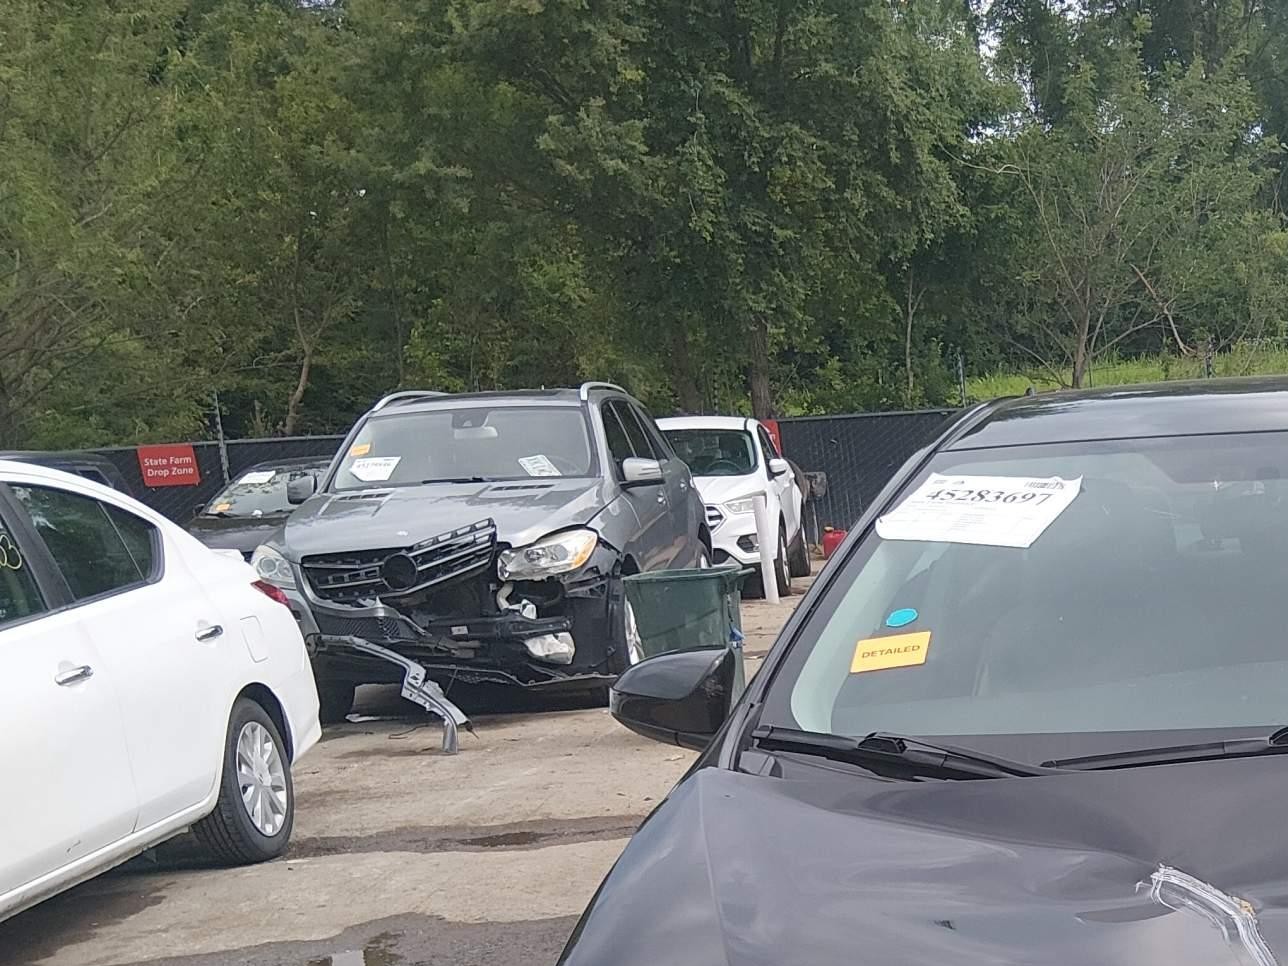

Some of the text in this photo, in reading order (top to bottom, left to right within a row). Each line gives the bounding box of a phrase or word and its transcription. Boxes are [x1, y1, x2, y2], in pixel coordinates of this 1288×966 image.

[144, 456, 192, 466] State Farm
[147, 466, 194, 478] Drop Zone
[926, 488, 1055, 506] 45283697
[861, 645, 921, 659] DETAILED
